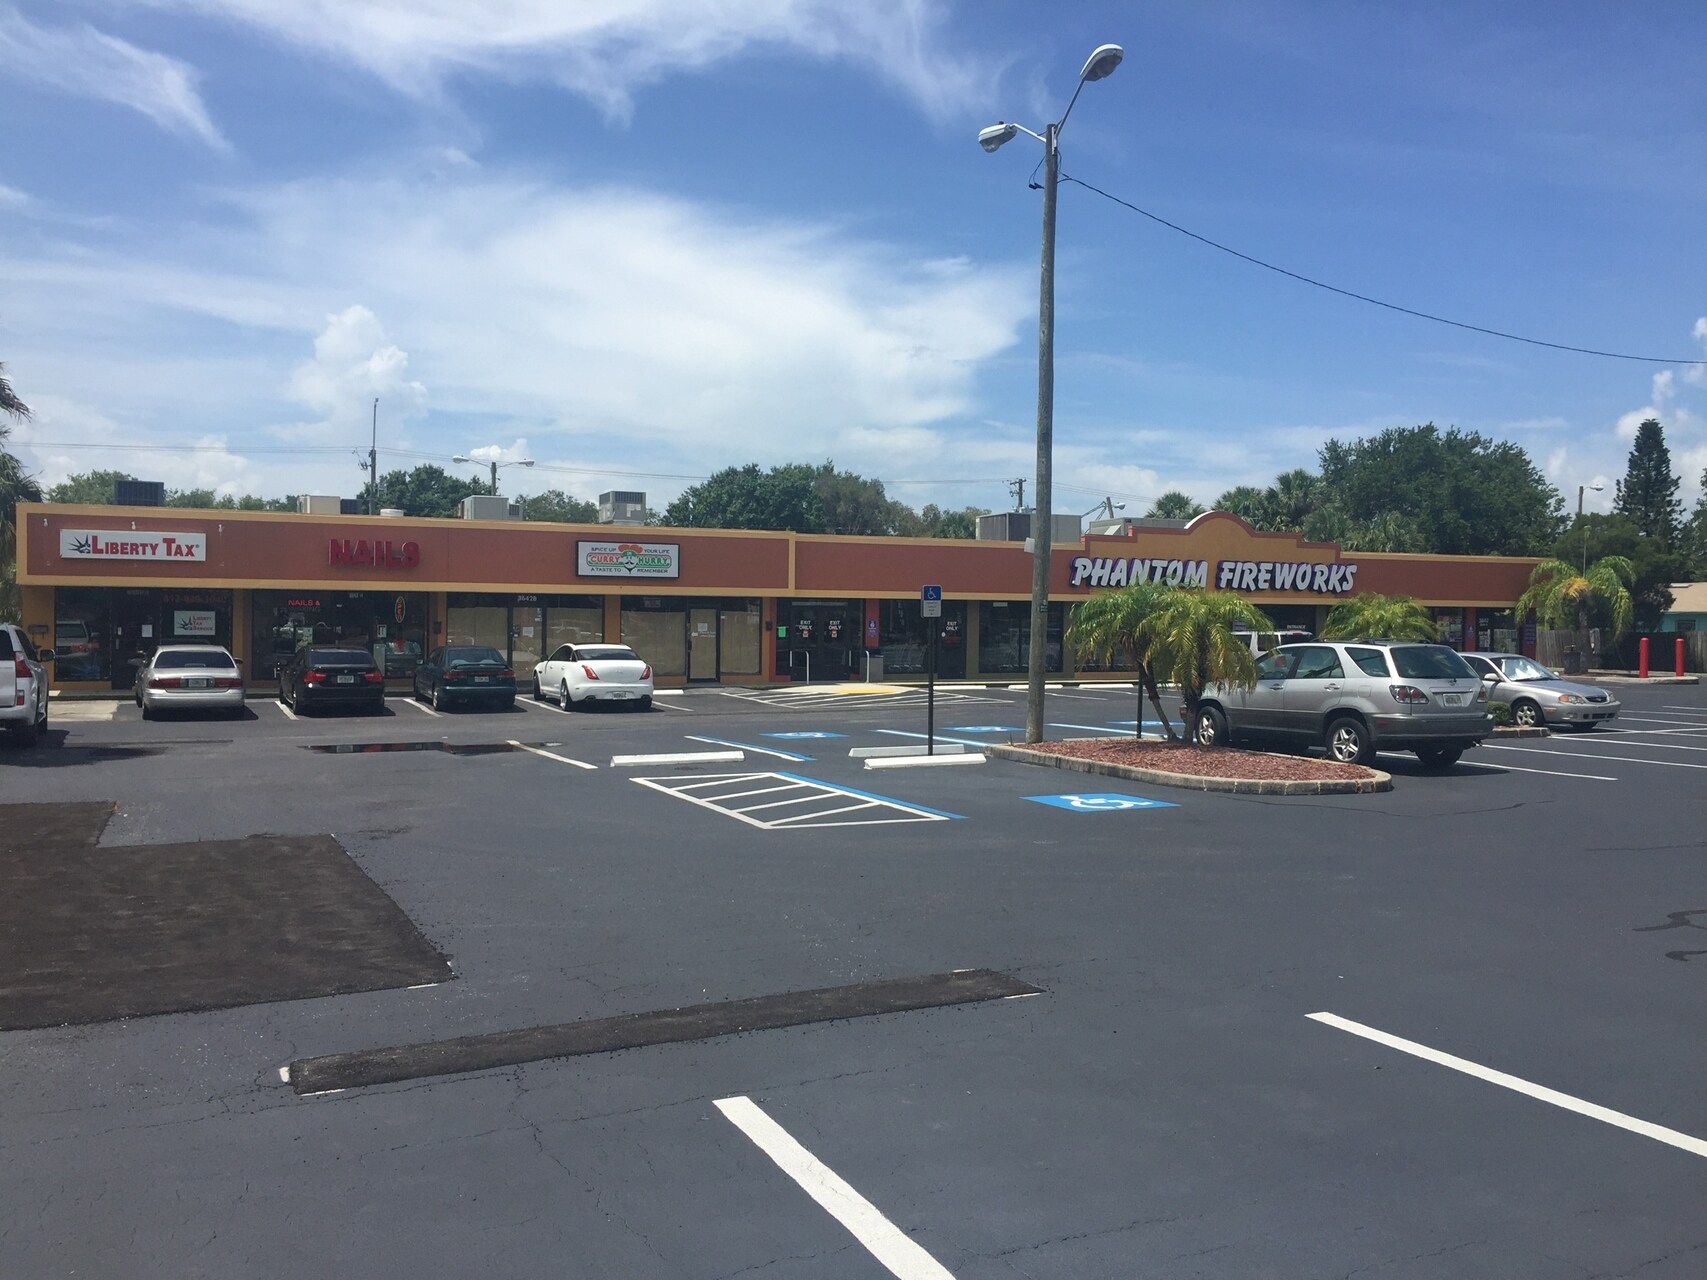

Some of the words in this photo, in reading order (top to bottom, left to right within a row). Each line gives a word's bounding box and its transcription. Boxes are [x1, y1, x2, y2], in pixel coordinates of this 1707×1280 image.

[329, 538, 420, 568] NAILS
[590, 555, 621, 563] CURRY
[638, 557, 668, 565] HURRY
[1071, 558, 1209, 588] PHANTOM
[1217, 561, 1358, 593] FIREWORKS
